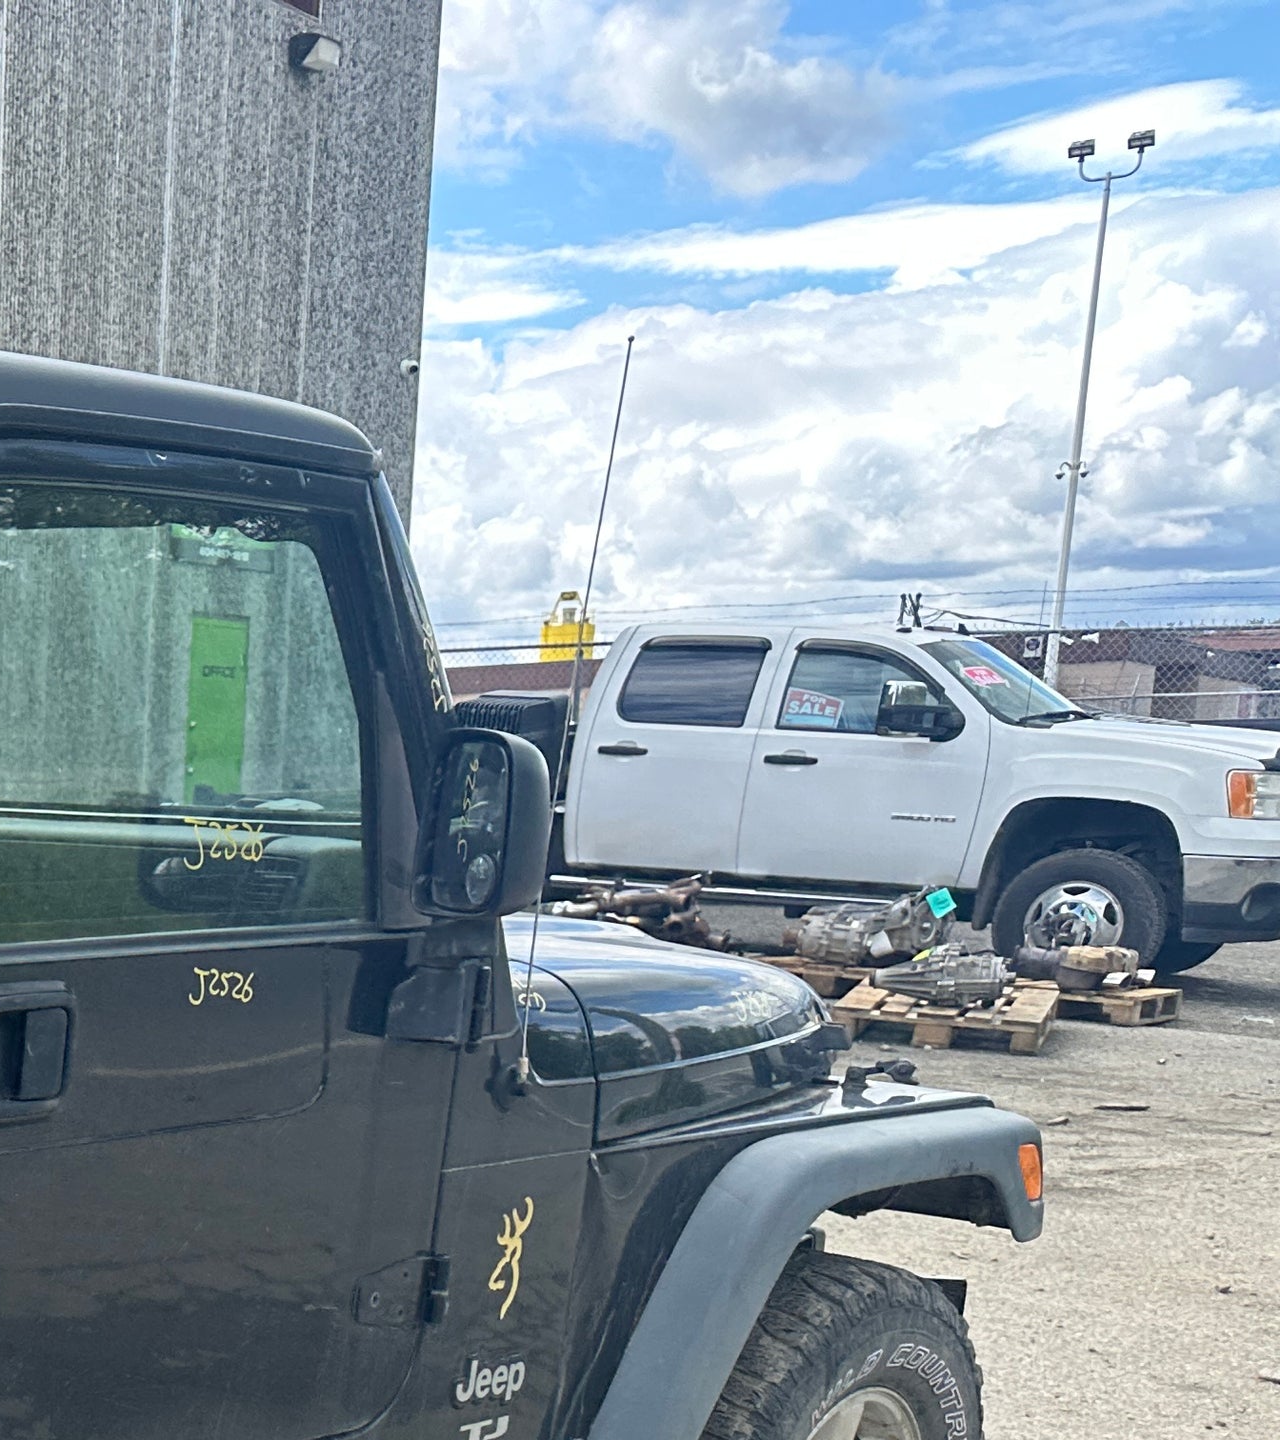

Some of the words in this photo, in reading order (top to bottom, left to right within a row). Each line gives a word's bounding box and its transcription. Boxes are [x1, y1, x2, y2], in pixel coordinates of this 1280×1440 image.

[788, 700, 837, 717] SALE
[802, 693, 827, 705] FOR
[184, 817, 264, 871] J2526
[189, 967, 255, 1006] J2526
[456, 1359, 526, 1402] Jeep
